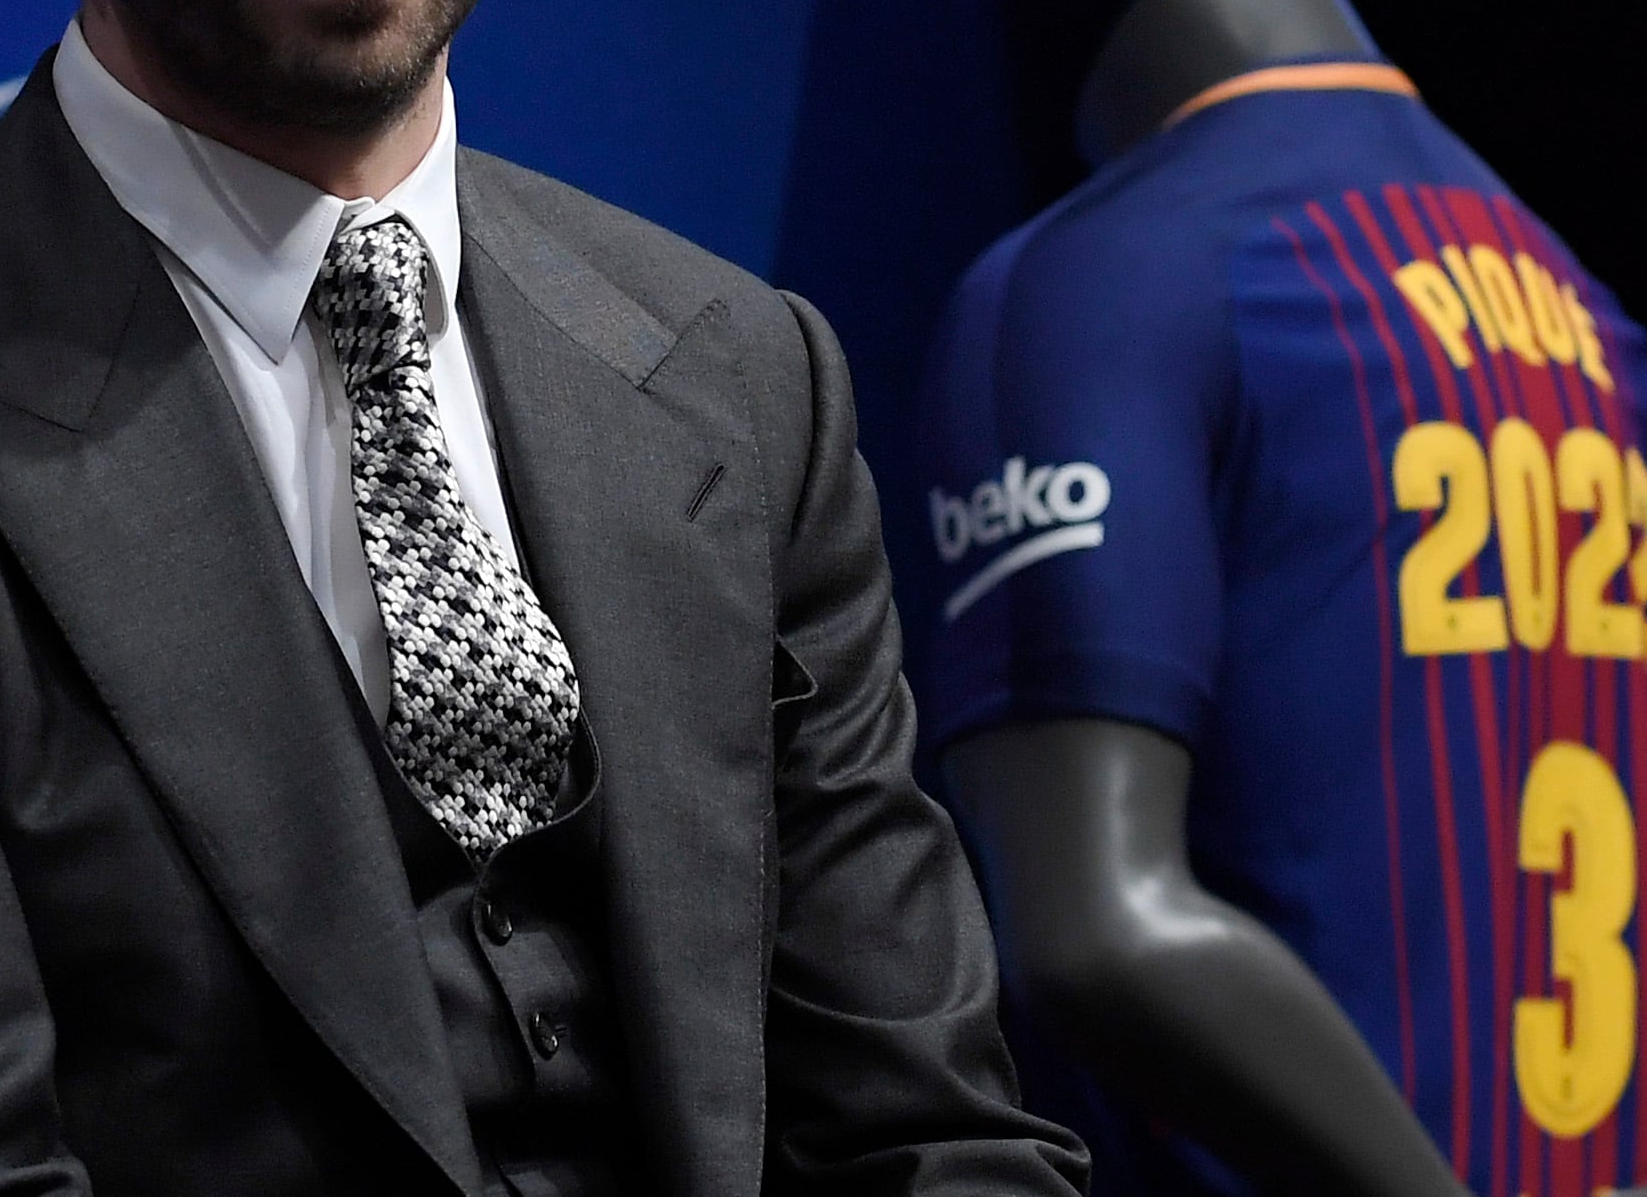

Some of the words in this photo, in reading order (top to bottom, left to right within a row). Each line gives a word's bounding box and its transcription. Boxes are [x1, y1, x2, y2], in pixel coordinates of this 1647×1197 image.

[929, 456, 1111, 562] beko
[1393, 417, 1647, 660] 202
[1513, 740, 1636, 1139] 3
